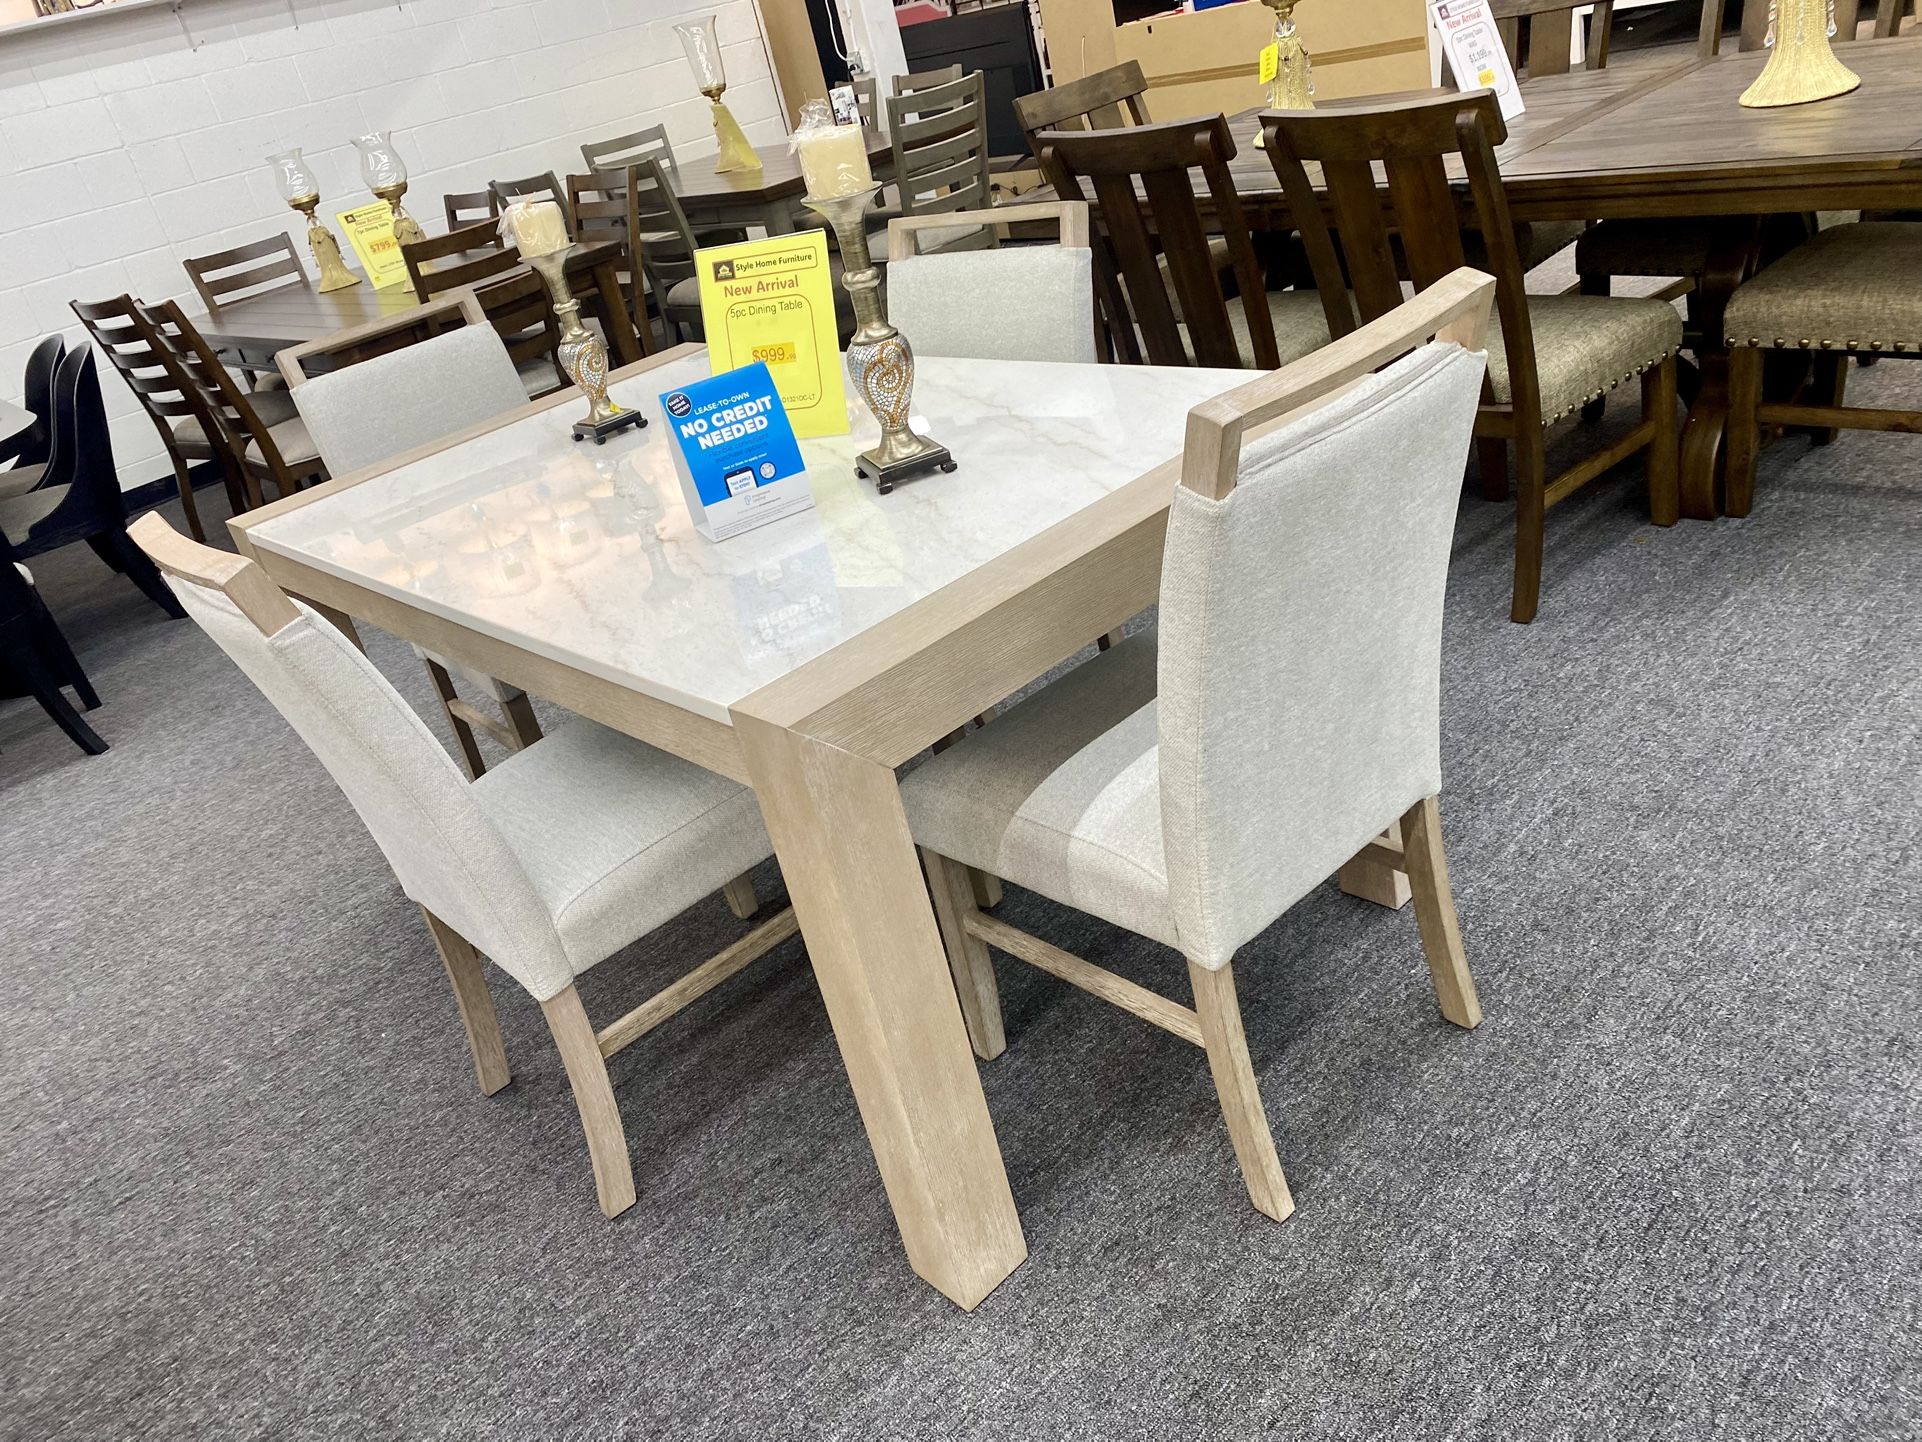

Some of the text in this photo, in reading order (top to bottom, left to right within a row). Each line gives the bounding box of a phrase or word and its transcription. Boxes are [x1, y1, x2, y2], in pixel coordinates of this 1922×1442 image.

[735, 254, 812, 272] Style Home Furniture
[724, 274, 800, 298] New Arrival
[730, 300, 803, 320] 5pc Dining Table
[672, 400, 686, 411] HOME
[694, 391, 750, 416] LEASE-TO-OWN
[680, 395, 772, 439] NO CREDIT
[697, 415, 769, 450] NEEDED
